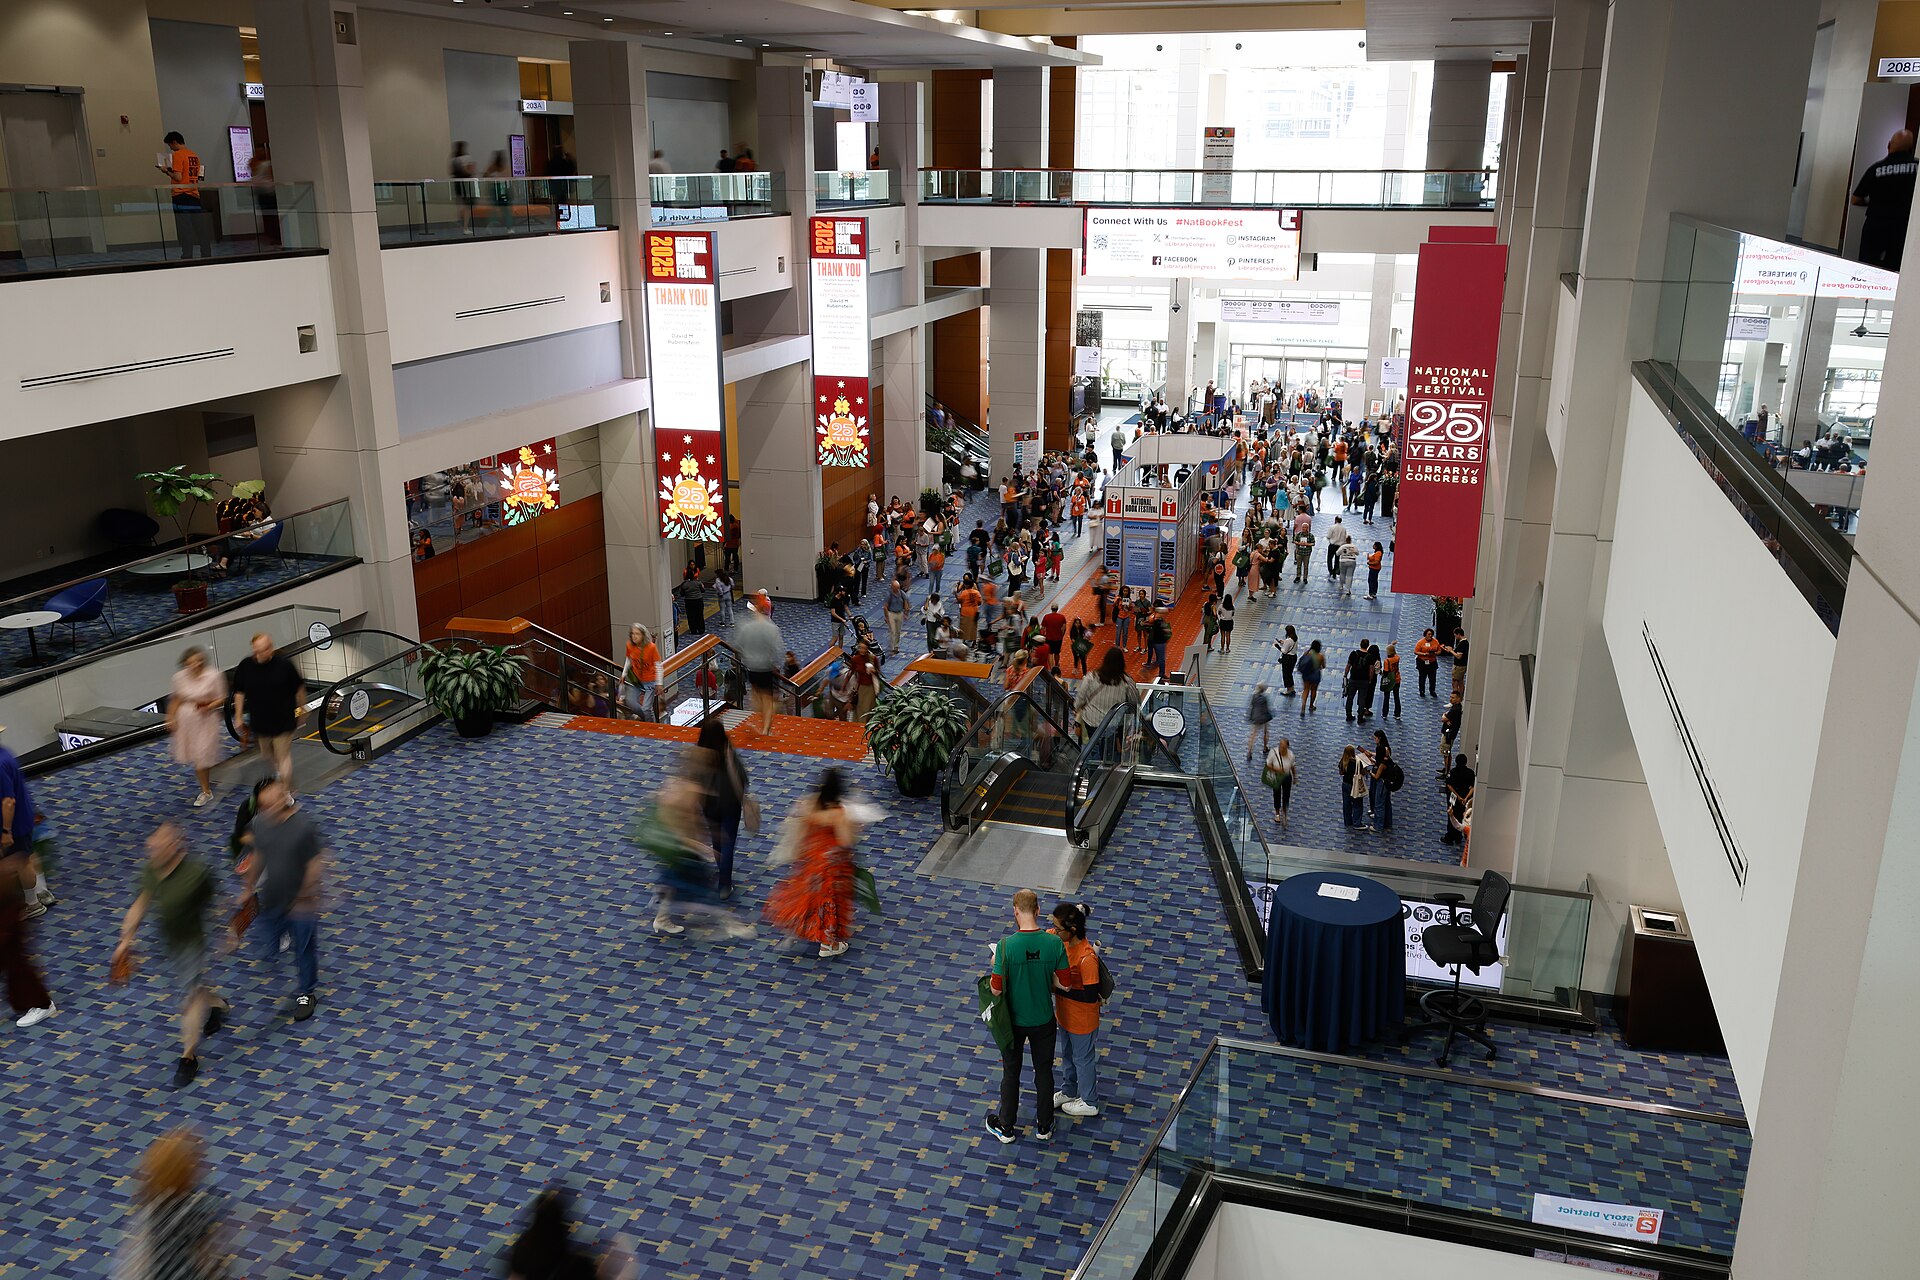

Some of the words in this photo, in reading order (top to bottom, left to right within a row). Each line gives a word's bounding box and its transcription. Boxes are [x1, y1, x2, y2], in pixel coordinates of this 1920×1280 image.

[1092, 217, 1131, 225] Connect
[814, 221, 834, 254] 2025
[650, 236, 674, 276] 2025
[817, 262, 843, 276] THANK
[845, 262, 861, 276] YOU
[655, 288, 686, 305] THANK
[688, 288, 708, 306] YOU
[1414, 366, 1489, 378] NATIONAL
[1431, 376, 1472, 386] BOOK
[1415, 385, 1485, 396] FESTIVAL
[832, 422, 854, 436] 25
[1410, 401, 1484, 443] 25
[1410, 444, 1479, 460] YEARS
[1407, 464, 1470, 474] LIBRARY
[1406, 473, 1478, 484] CONGRESS
[678, 486, 704, 504] 25
[1125, 504, 1138, 512] BOOK
[1138, 506, 1158, 514] FESTIVAL
[1106, 538, 1120, 568] BOOKS
[1160, 542, 1174, 570] BOOKS
